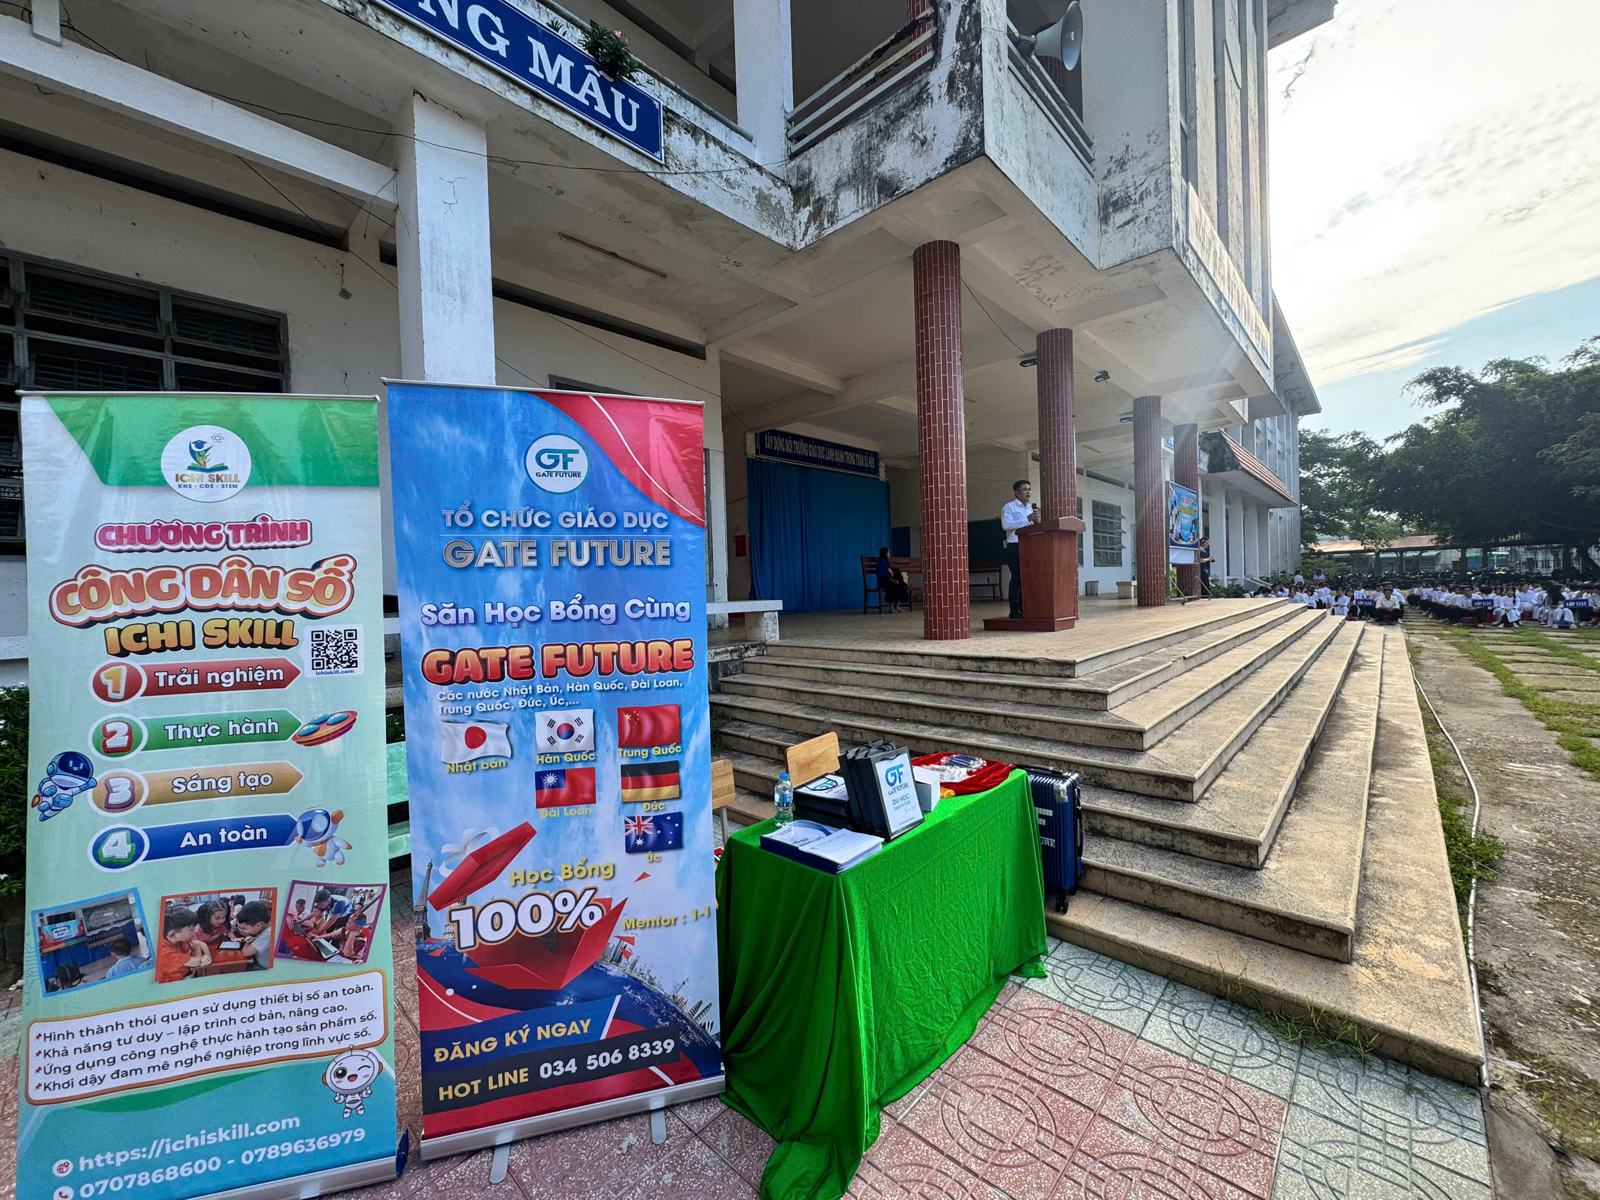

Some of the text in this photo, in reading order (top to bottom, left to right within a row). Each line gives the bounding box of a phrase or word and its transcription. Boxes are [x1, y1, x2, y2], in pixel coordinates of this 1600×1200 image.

[535, 448, 579, 470] GF
[208, 474, 240, 483] SKILL
[97, 514, 310, 549] CHƯƠNG TRÌNH
[442, 500, 669, 534] TỔ CHỨC GIÁO DỤC
[442, 539, 671, 568] GATE FUTURE
[55, 557, 355, 616] CÔNG DÂN SỐ
[421, 594, 691, 628] Săn Học Bổng Cùng
[104, 618, 300, 656] ICHI SKILL
[154, 665, 284, 690] Trải nghiệm
[422, 638, 694, 685] GATE FUTURE
[101, 666, 126, 698] 1
[437, 678, 683, 701] Các nước Nhật Bản, Hàn Quốc, Đài Loan,
[437, 694, 579, 716] Trung Quốc, Đức, Úc,...
[102, 720, 134, 752] 2
[165, 718, 280, 743] Thực hành
[446, 758, 506, 774] Nhật bản
[535, 749, 596, 765] Hàn Quốc
[618, 743, 682, 760] Trung Quốc
[171, 771, 273, 794] Sáng tạo
[885, 763, 904, 787] GF
[103, 776, 136, 810] 3
[642, 800, 665, 812] Đức
[563, 804, 592, 816] Loan
[101, 830, 136, 864] 4
[179, 825, 268, 849] An toàn
[509, 857, 616, 888] Học Bổng
[448, 887, 606, 950] 100%
[621, 914, 678, 931] Mentor
[43, 982, 375, 1041] Hình thành thói quen sử dụng thiết bị số an toàn.
[43, 1044, 70, 1060] Khả
[73, 1038, 113, 1054] năng
[116, 1034, 133, 1047] tư
[136, 1029, 163, 1044] duy
[178, 1022, 202, 1036] lập
[204, 1015, 236, 1030] trình
[239, 1014, 256, 1025] cơ
[259, 1008, 286, 1022] bản,
[288, 1004, 319, 1018] nâng
[322, 1004, 348, 1014] cao.
[43, 1010, 378, 1076] Ứng dụng công nghệ thực hành tạo sản phẩm số.
[433, 1018, 592, 1063] ĐĂNG KÝ NGAY
[43, 1026, 372, 1093] Khơi dậy đam mê nghề nghiệp trong lĩnh vực số.
[438, 1038, 675, 1101] HOT LINE 034 506 8339
[79, 1114, 301, 1172] https://ichiskill.com
[79, 1156, 221, 1198] 0707868600
[240, 1128, 366, 1166] 0789636979
